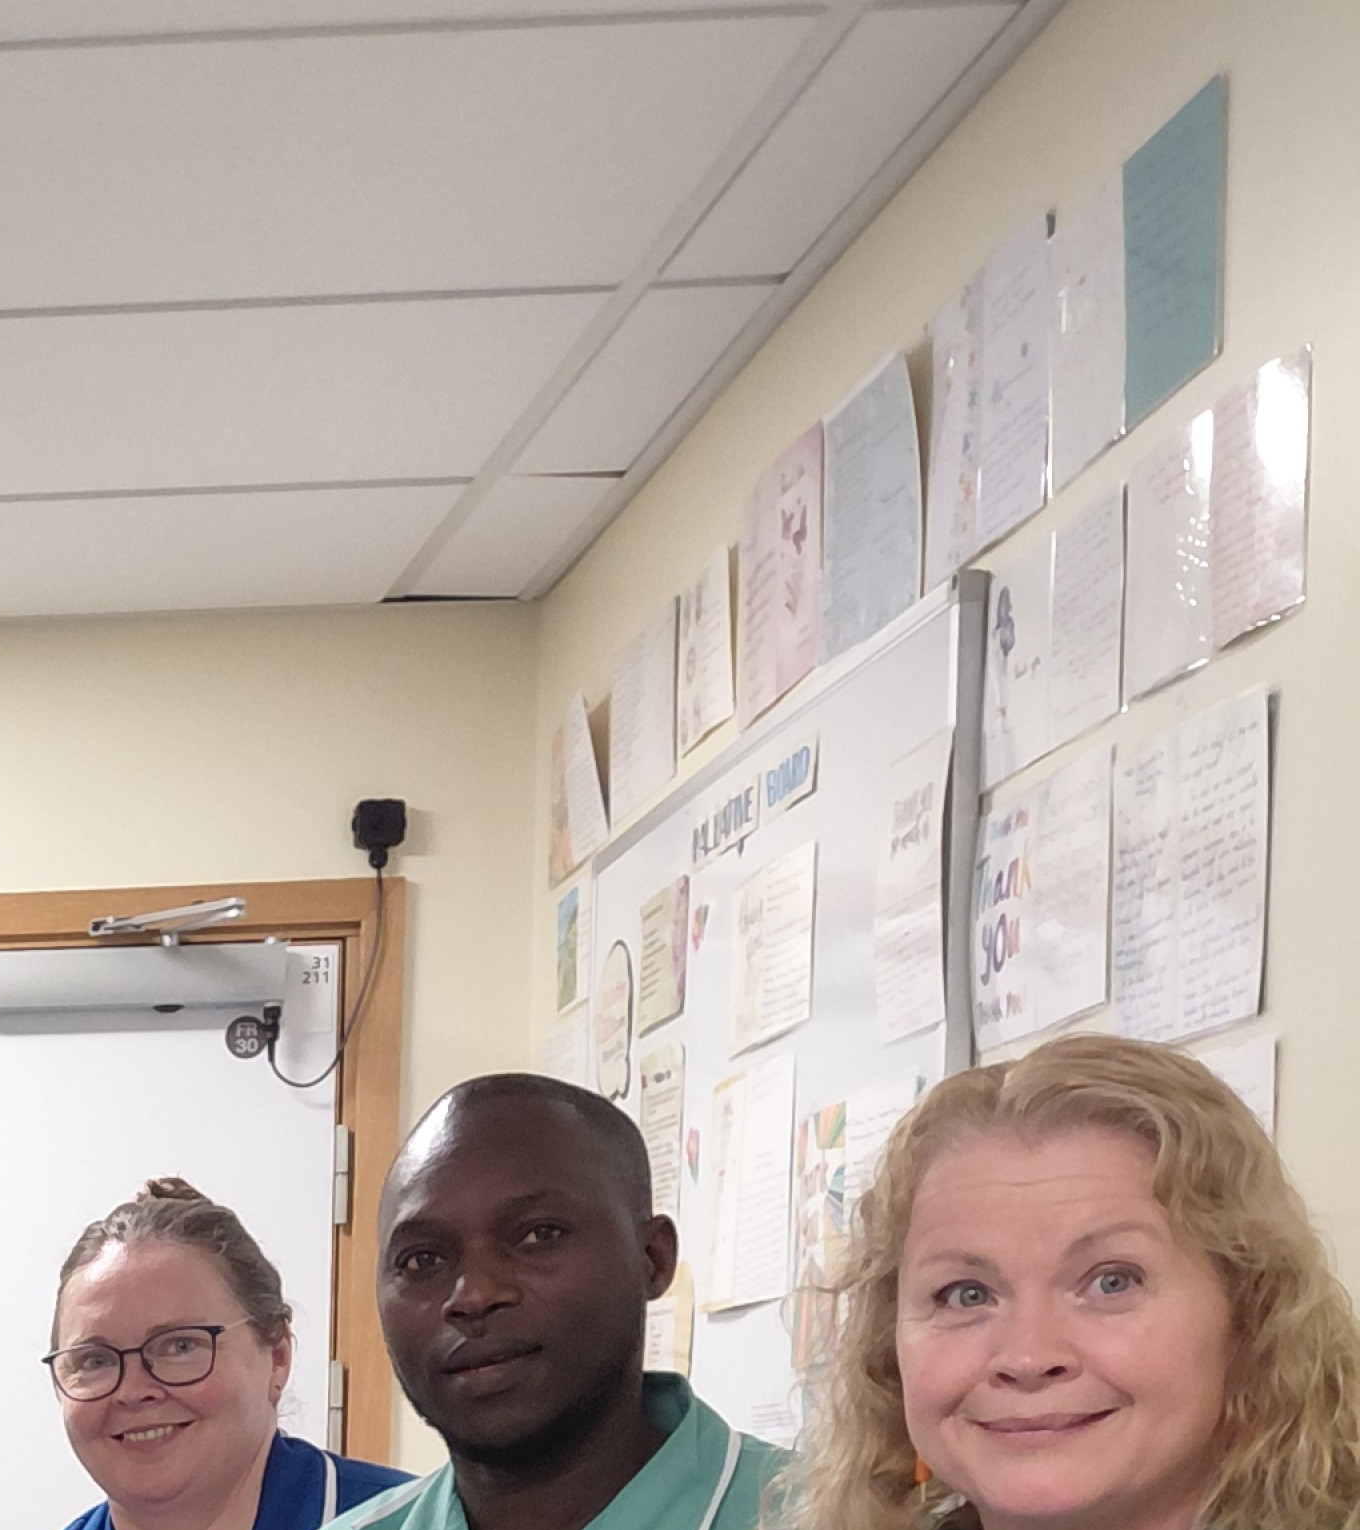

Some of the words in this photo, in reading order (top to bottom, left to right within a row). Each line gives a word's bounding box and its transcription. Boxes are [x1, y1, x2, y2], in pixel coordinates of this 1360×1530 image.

[312, 956, 330, 970] 31
[302, 971, 330, 985] 211
[235, 1021, 258, 1038] FR
[235, 1037, 260, 1053] 30
